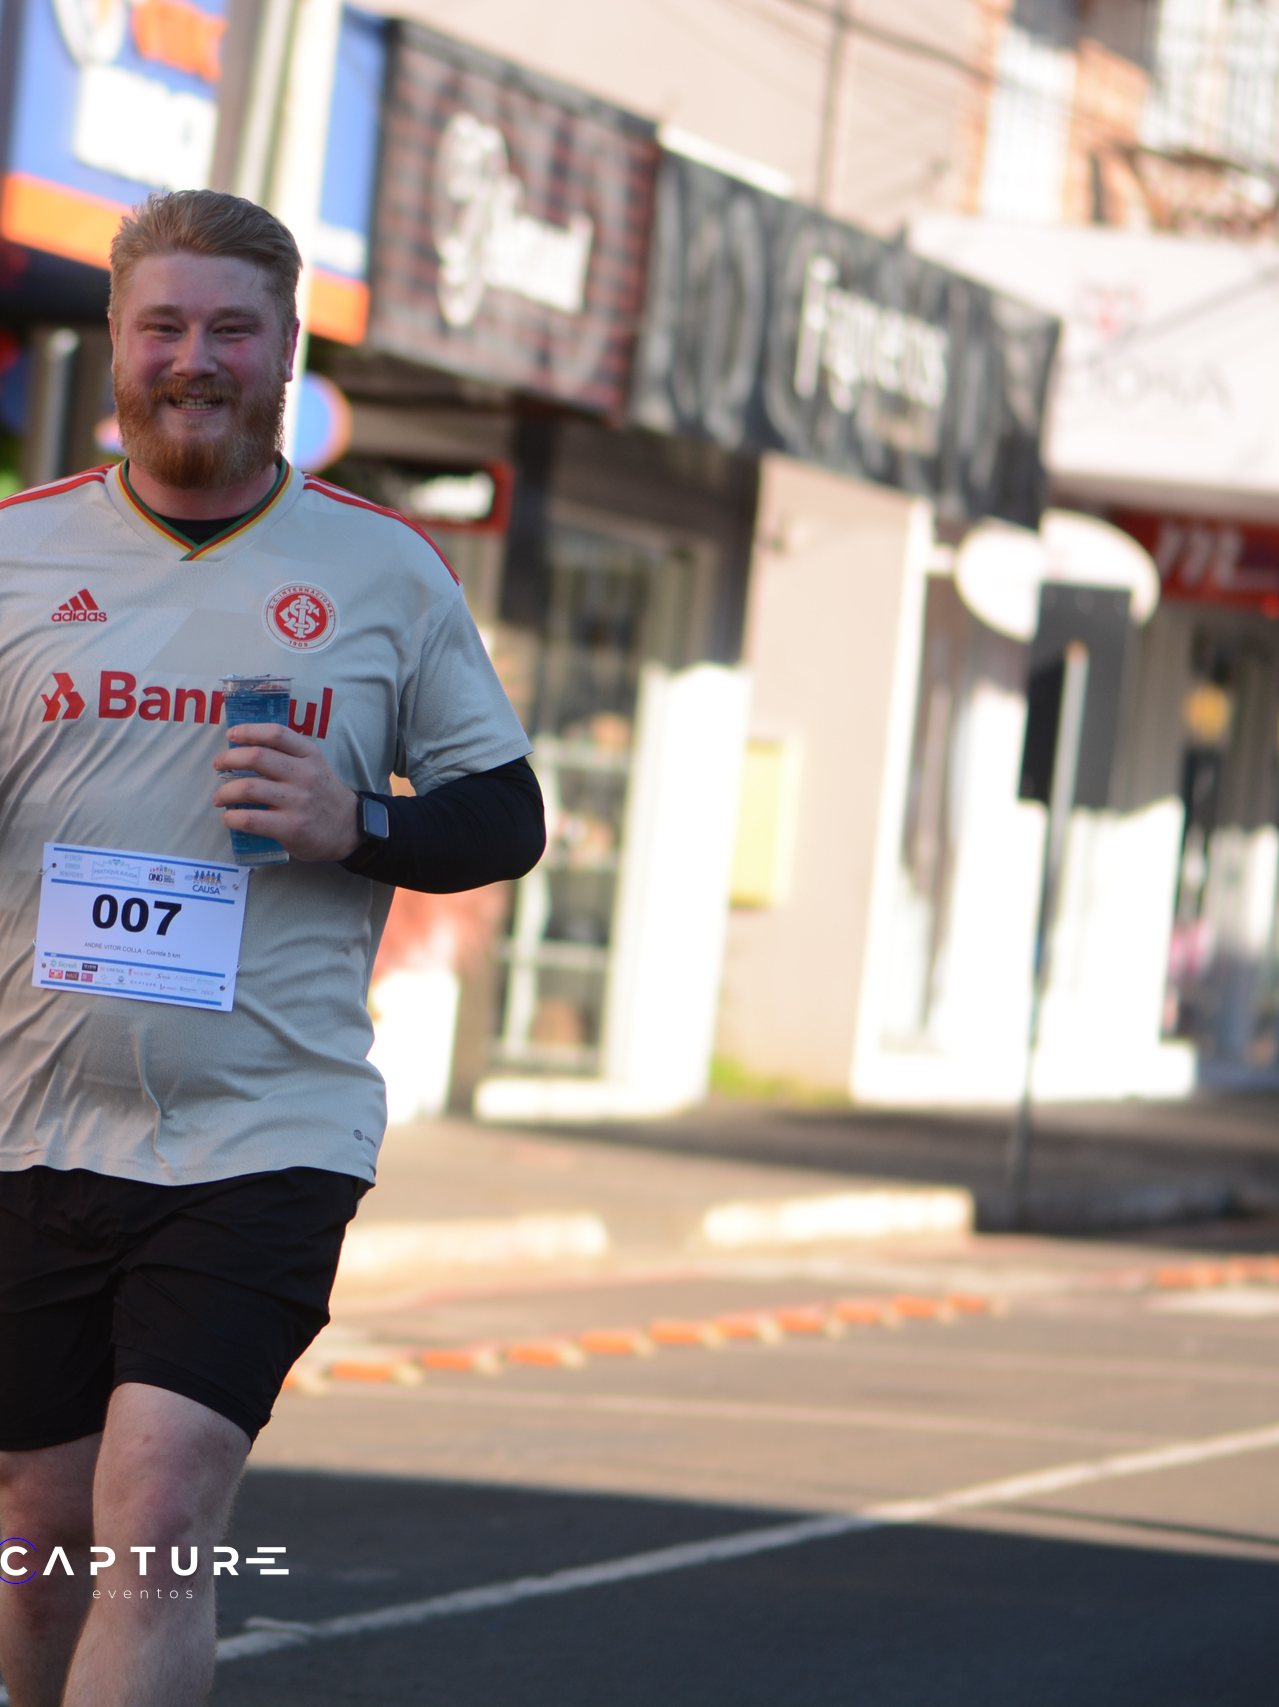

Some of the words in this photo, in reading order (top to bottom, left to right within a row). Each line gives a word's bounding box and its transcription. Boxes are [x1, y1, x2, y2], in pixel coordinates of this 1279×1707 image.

[51, 609, 108, 623] adidas
[289, 640, 309, 648] 1909
[98, 670, 334, 740] Banrul
[148, 872, 163, 882] ONG
[192, 884, 220, 895] CAUSA
[92, 893, 182, 936] 007
[122, 946, 142, 954] COLLA
[146, 949, 166, 957] Corrida
[58, 961, 77, 969] Sicredi
